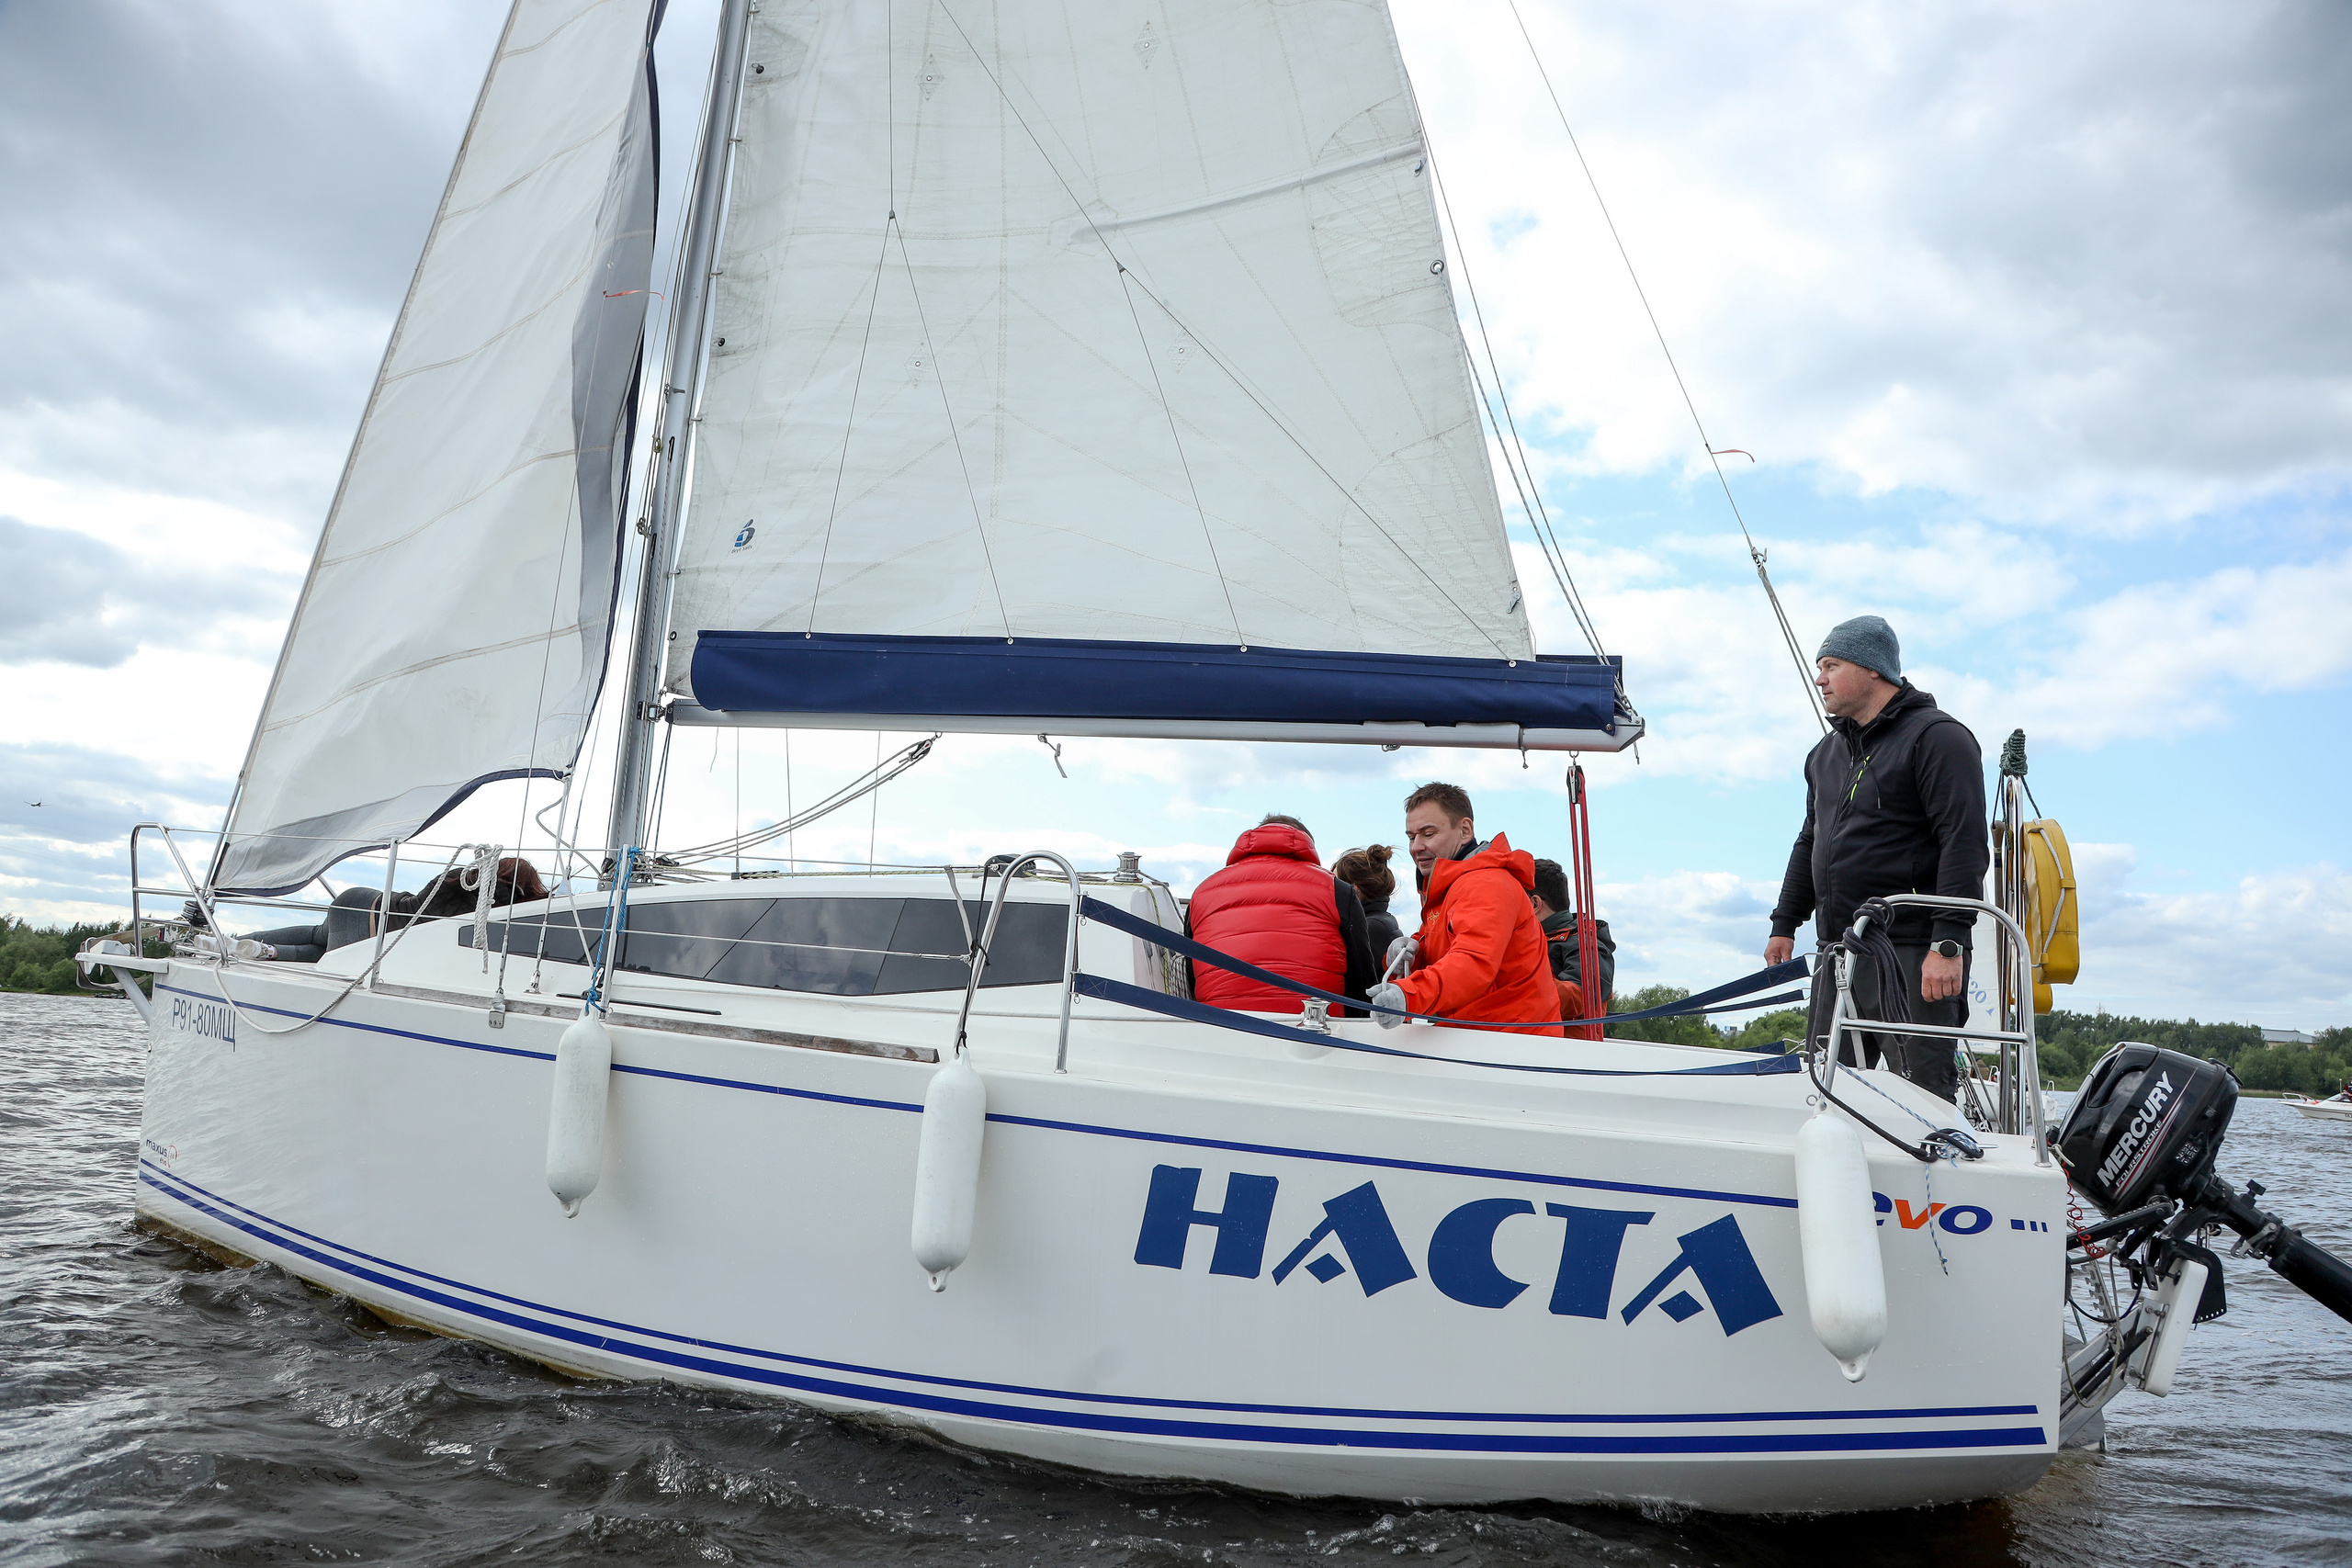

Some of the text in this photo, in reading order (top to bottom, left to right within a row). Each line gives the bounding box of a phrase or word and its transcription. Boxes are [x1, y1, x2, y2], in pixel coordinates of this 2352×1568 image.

[173, 998, 235, 1052] Р91-80МЩ
[146, 1139, 167, 1157] maxus
[2097, 1070, 2174, 1188] MERCURY
[2115, 1120, 2163, 1188] FOURSTROKE
[1134, 1164, 1783, 1337] НАСТА
